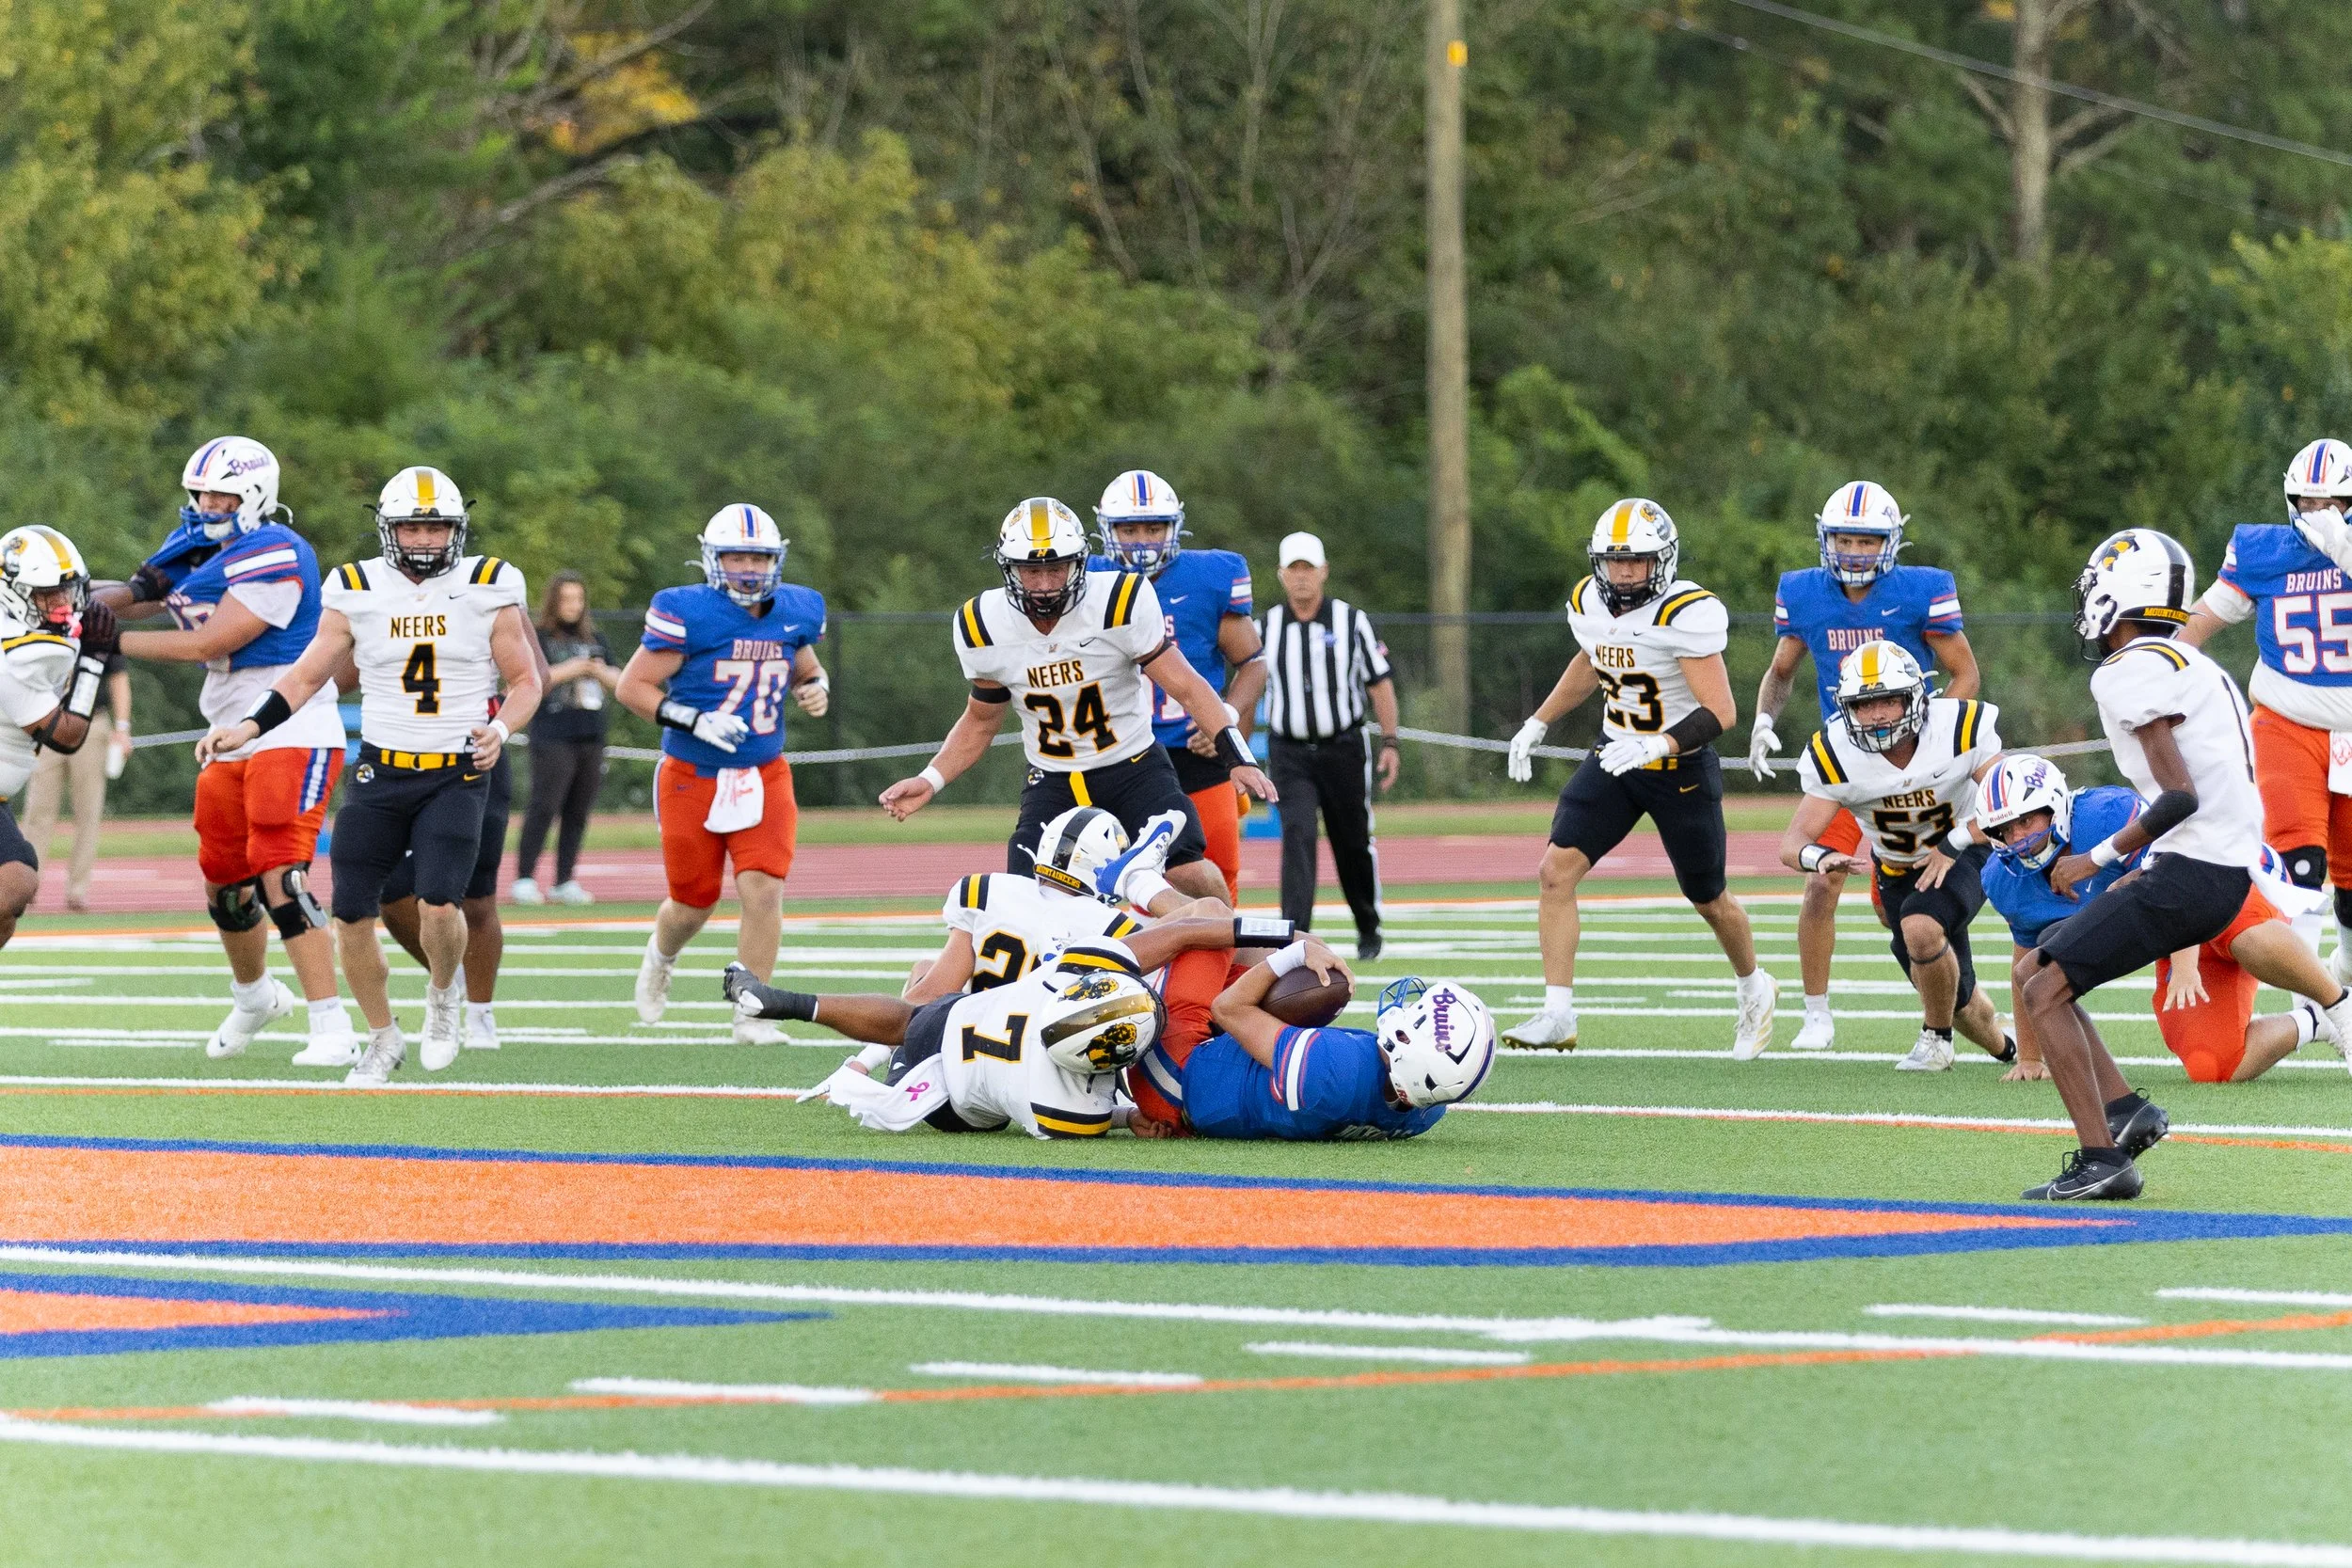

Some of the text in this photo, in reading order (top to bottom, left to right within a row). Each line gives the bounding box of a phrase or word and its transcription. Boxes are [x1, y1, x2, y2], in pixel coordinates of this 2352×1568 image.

[2285, 569, 2343, 594] BRUINS
[389, 614, 447, 639] NEERS
[731, 638, 784, 660] BRUINS
[2273, 592, 2352, 675] 55
[401, 641, 441, 716] 4
[1026, 659, 1085, 689] NEERS
[1595, 643, 1635, 668] NEERS
[714, 659, 790, 736] 70
[1023, 680, 1120, 759] 24
[1595, 666, 1664, 735] 23
[1881, 788, 1937, 809] NEERS
[1872, 800, 1956, 855] 53
[961, 1011, 1030, 1064] 7
[1432, 988, 1457, 1053] Bruins
